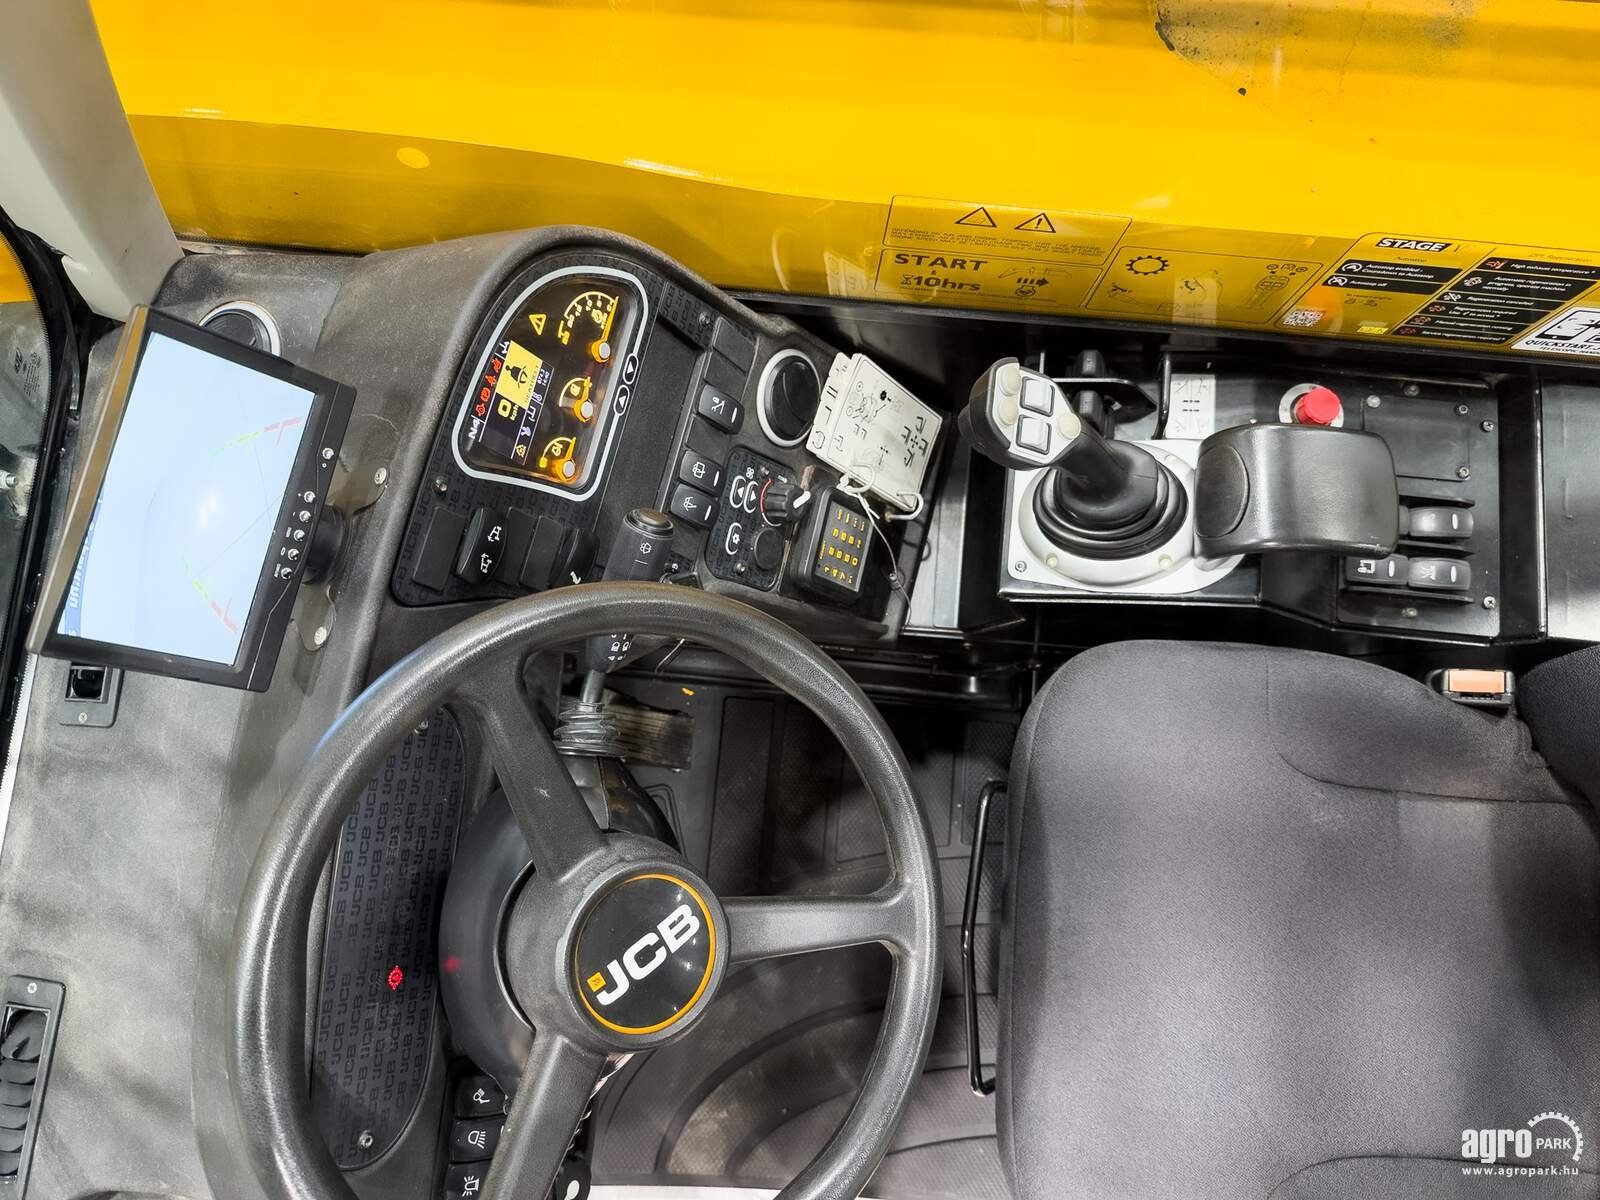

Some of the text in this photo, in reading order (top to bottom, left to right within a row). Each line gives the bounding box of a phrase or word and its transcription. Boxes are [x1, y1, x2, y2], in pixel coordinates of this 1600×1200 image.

[894, 253, 986, 271] START
[1379, 239, 1445, 252] STAGE
[912, 275, 981, 292] 10hrs
[428, 734, 440, 772] JCB
[382, 754, 396, 794] JCB
[410, 756, 424, 795] JCB
[346, 801, 360, 842] JCB
[376, 802, 389, 842] JCB
[340, 850, 353, 892] JCB
[370, 850, 383, 891] JCB
[331, 1023, 345, 1065] JCB
[351, 874, 365, 916] JCB
[358, 826, 371, 867] JCB
[365, 778, 378, 818] JCB
[589, 904, 700, 1006] JCB
